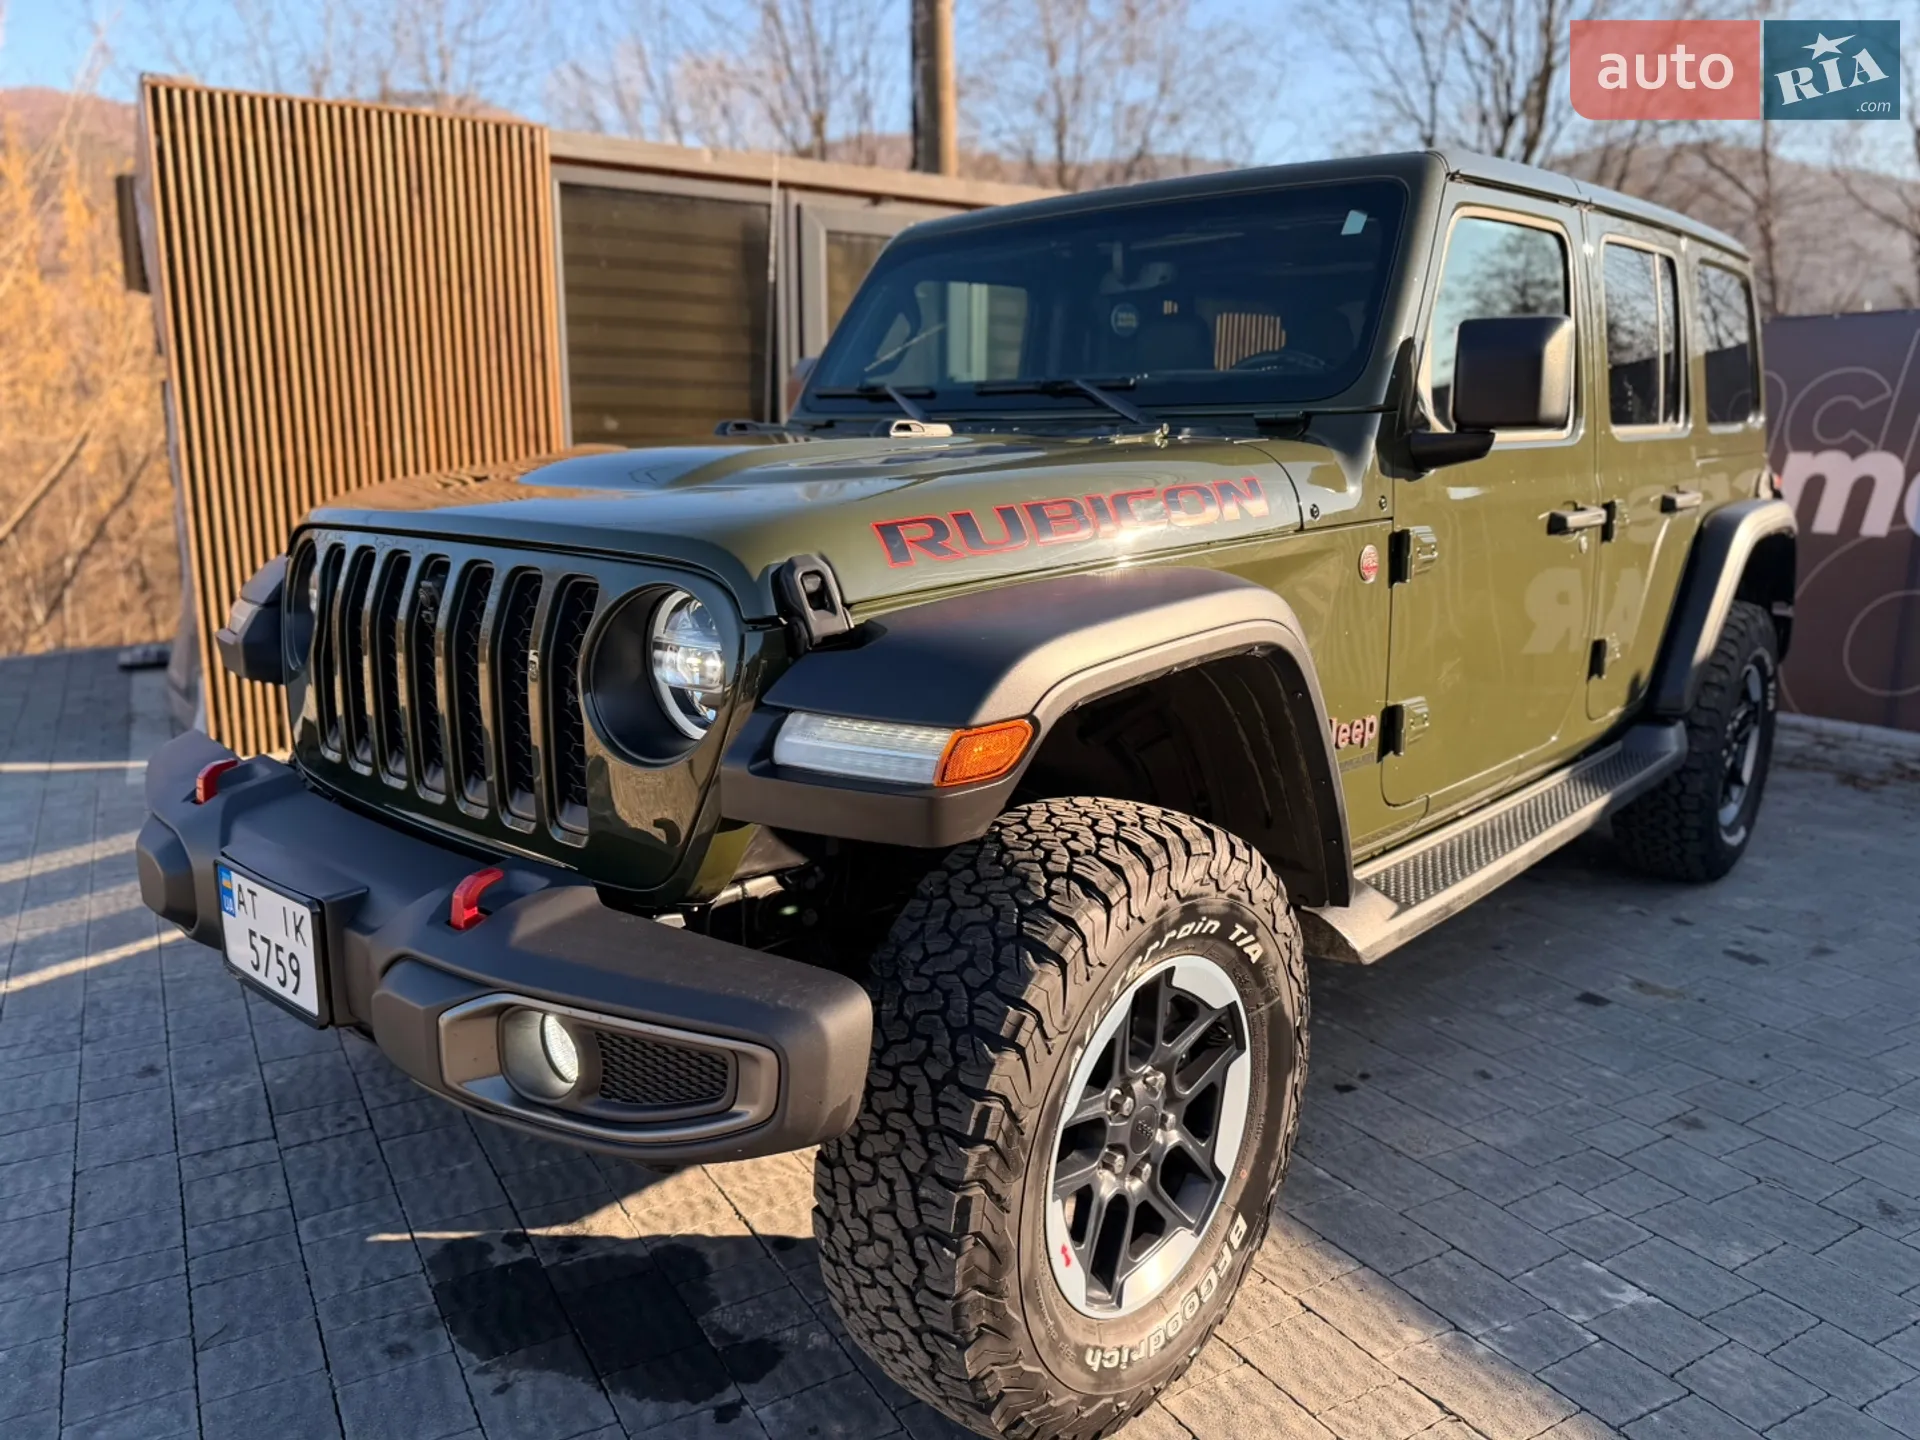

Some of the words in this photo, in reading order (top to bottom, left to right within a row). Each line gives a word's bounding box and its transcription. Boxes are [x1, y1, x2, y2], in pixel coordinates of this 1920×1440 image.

[870, 476, 1270, 568] RUBICON
[237, 883, 258, 920] AT
[282, 906, 307, 947] IK
[1228, 923, 1264, 964] T/A
[248, 928, 301, 996] 5759
[1084, 1212, 1248, 1372] BFGoodrich
